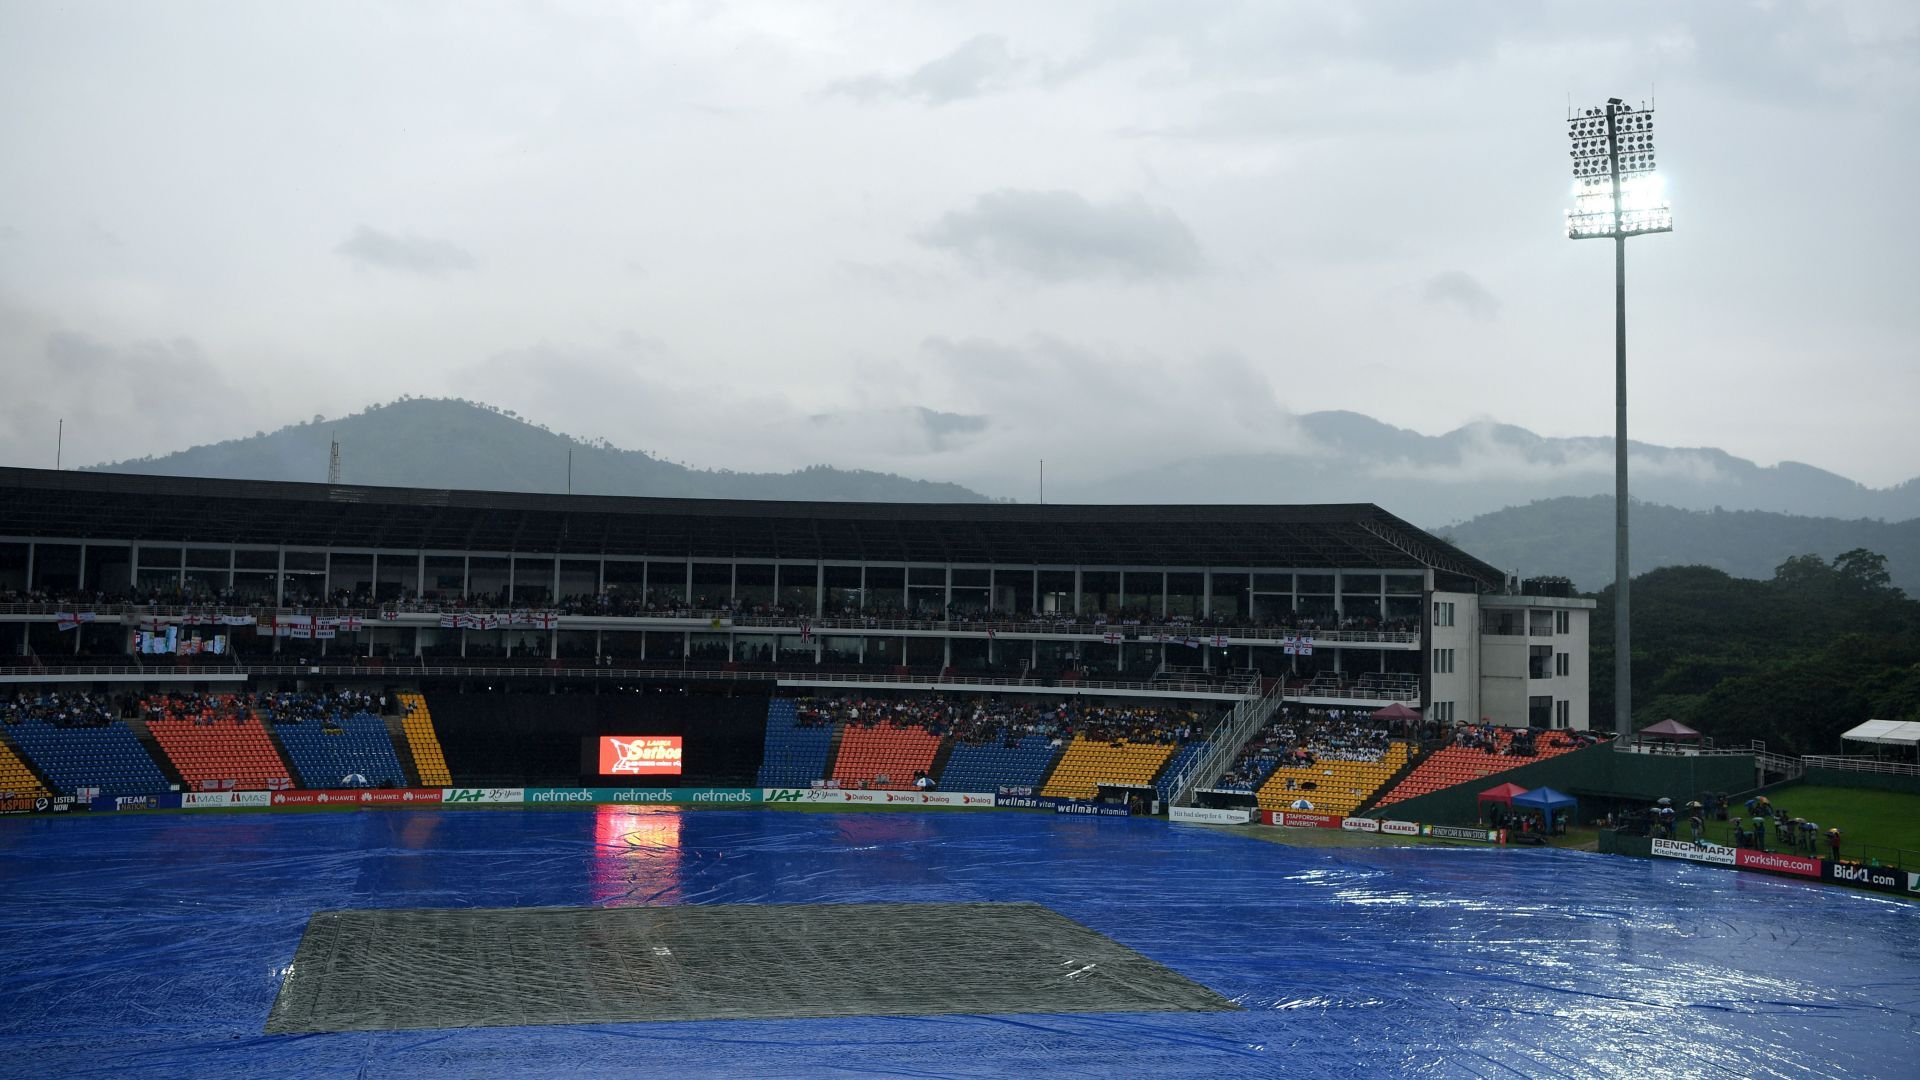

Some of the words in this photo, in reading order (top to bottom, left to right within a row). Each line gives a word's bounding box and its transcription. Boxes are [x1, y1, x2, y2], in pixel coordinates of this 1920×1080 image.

[197, 794, 223, 802] MAS
[241, 794, 267, 802] MAS
[532, 788, 593, 802] netmeds
[613, 788, 673, 802] netmeds
[692, 788, 751, 802] netmeds
[852, 793, 873, 802] Dialog
[894, 794, 915, 803] Dialog
[929, 795, 950, 803] Dialog
[53, 796, 76, 804] LISTEN
[970, 796, 991, 805] Dialog
[53, 803, 69, 812] NOW
[1100, 808, 1128, 816] vitamins
[1194, 811, 1209, 820] sleep
[1286, 813, 1330, 822] STAFFORDSHIRE
[1286, 820, 1318, 828] UNIVERSITY
[1344, 821, 1376, 829] CARAMEL
[1383, 824, 1416, 832] CARAMEL
[1448, 829, 1458, 837] CAR
[1462, 830, 1472, 838] VAN
[1472, 831, 1487, 840] STORE
[1654, 839, 1734, 857] BENCHMARX
[1653, 848, 1687, 858] Kitchens
[1689, 852, 1703, 860] and
[1705, 854, 1734, 864] Joinery
[1744, 854, 1813, 871] yorkshire.com
